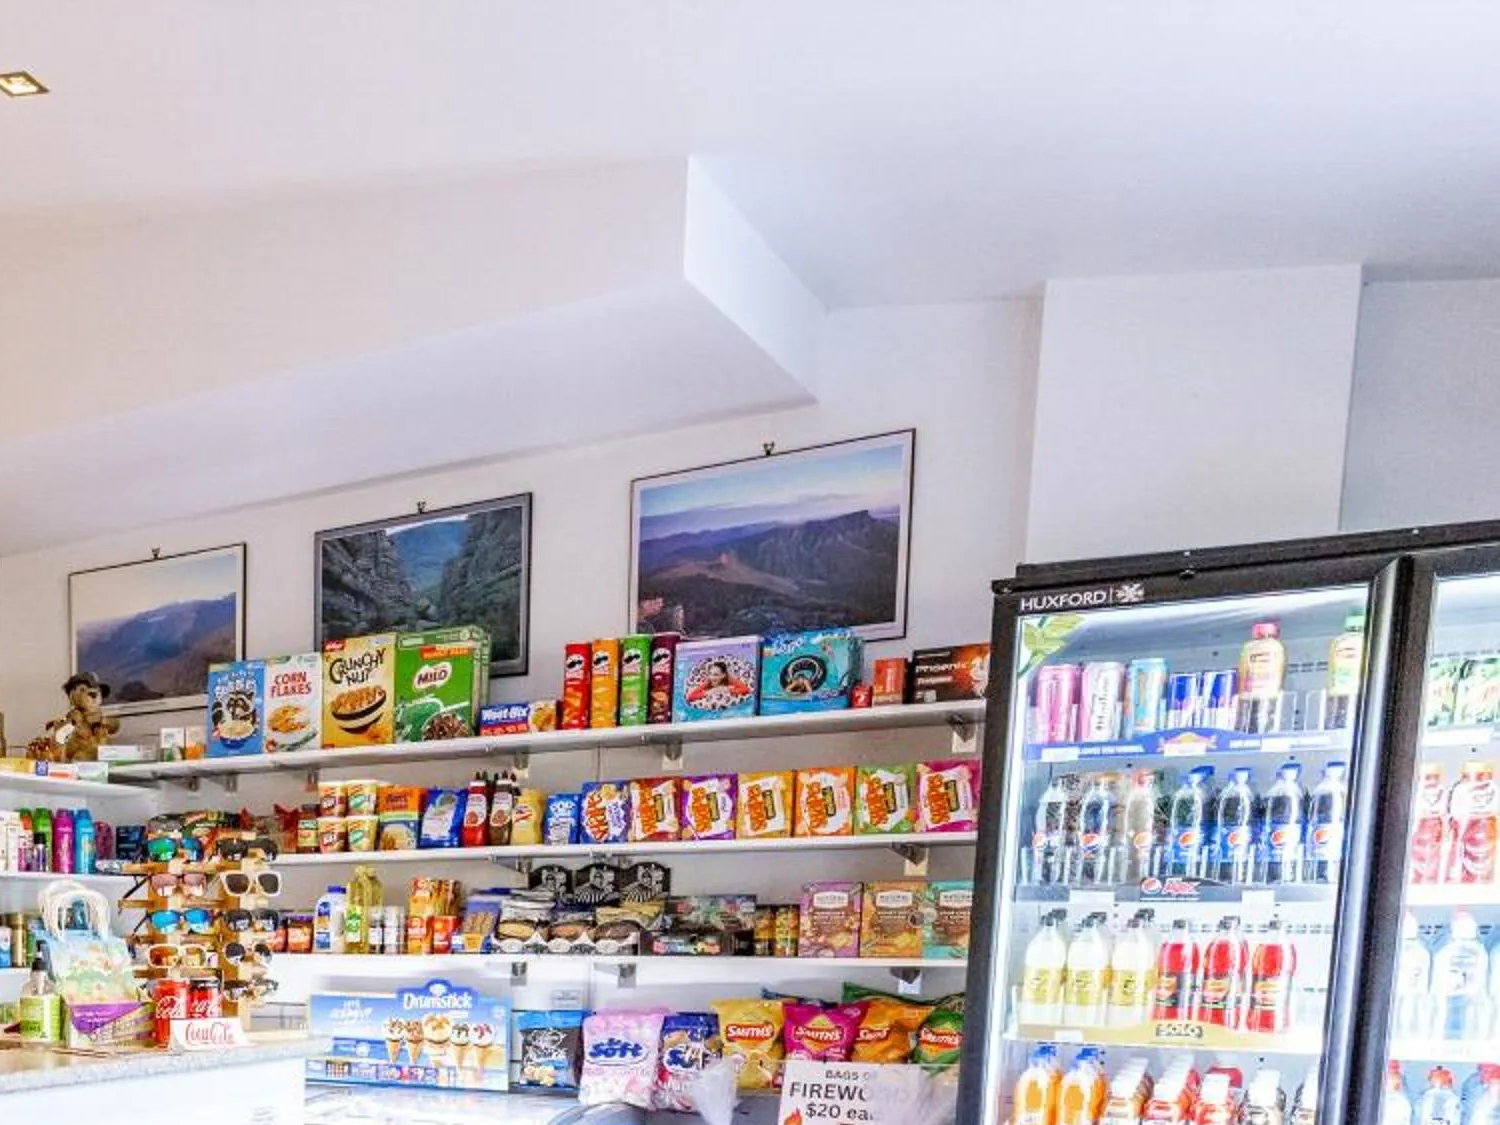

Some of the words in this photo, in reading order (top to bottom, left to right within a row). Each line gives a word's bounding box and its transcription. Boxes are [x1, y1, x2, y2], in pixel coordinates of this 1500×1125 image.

[1020, 590, 1107, 611] HUXFORD
[329, 648, 386, 685] CRUNCHY
[275, 671, 307, 685] CORN
[346, 668, 372, 686] NUT
[417, 669, 448, 687] MILO
[271, 682, 312, 698] FLAKES
[403, 992, 472, 1010] Drumstick
[805, 1102, 841, 1119] $20
